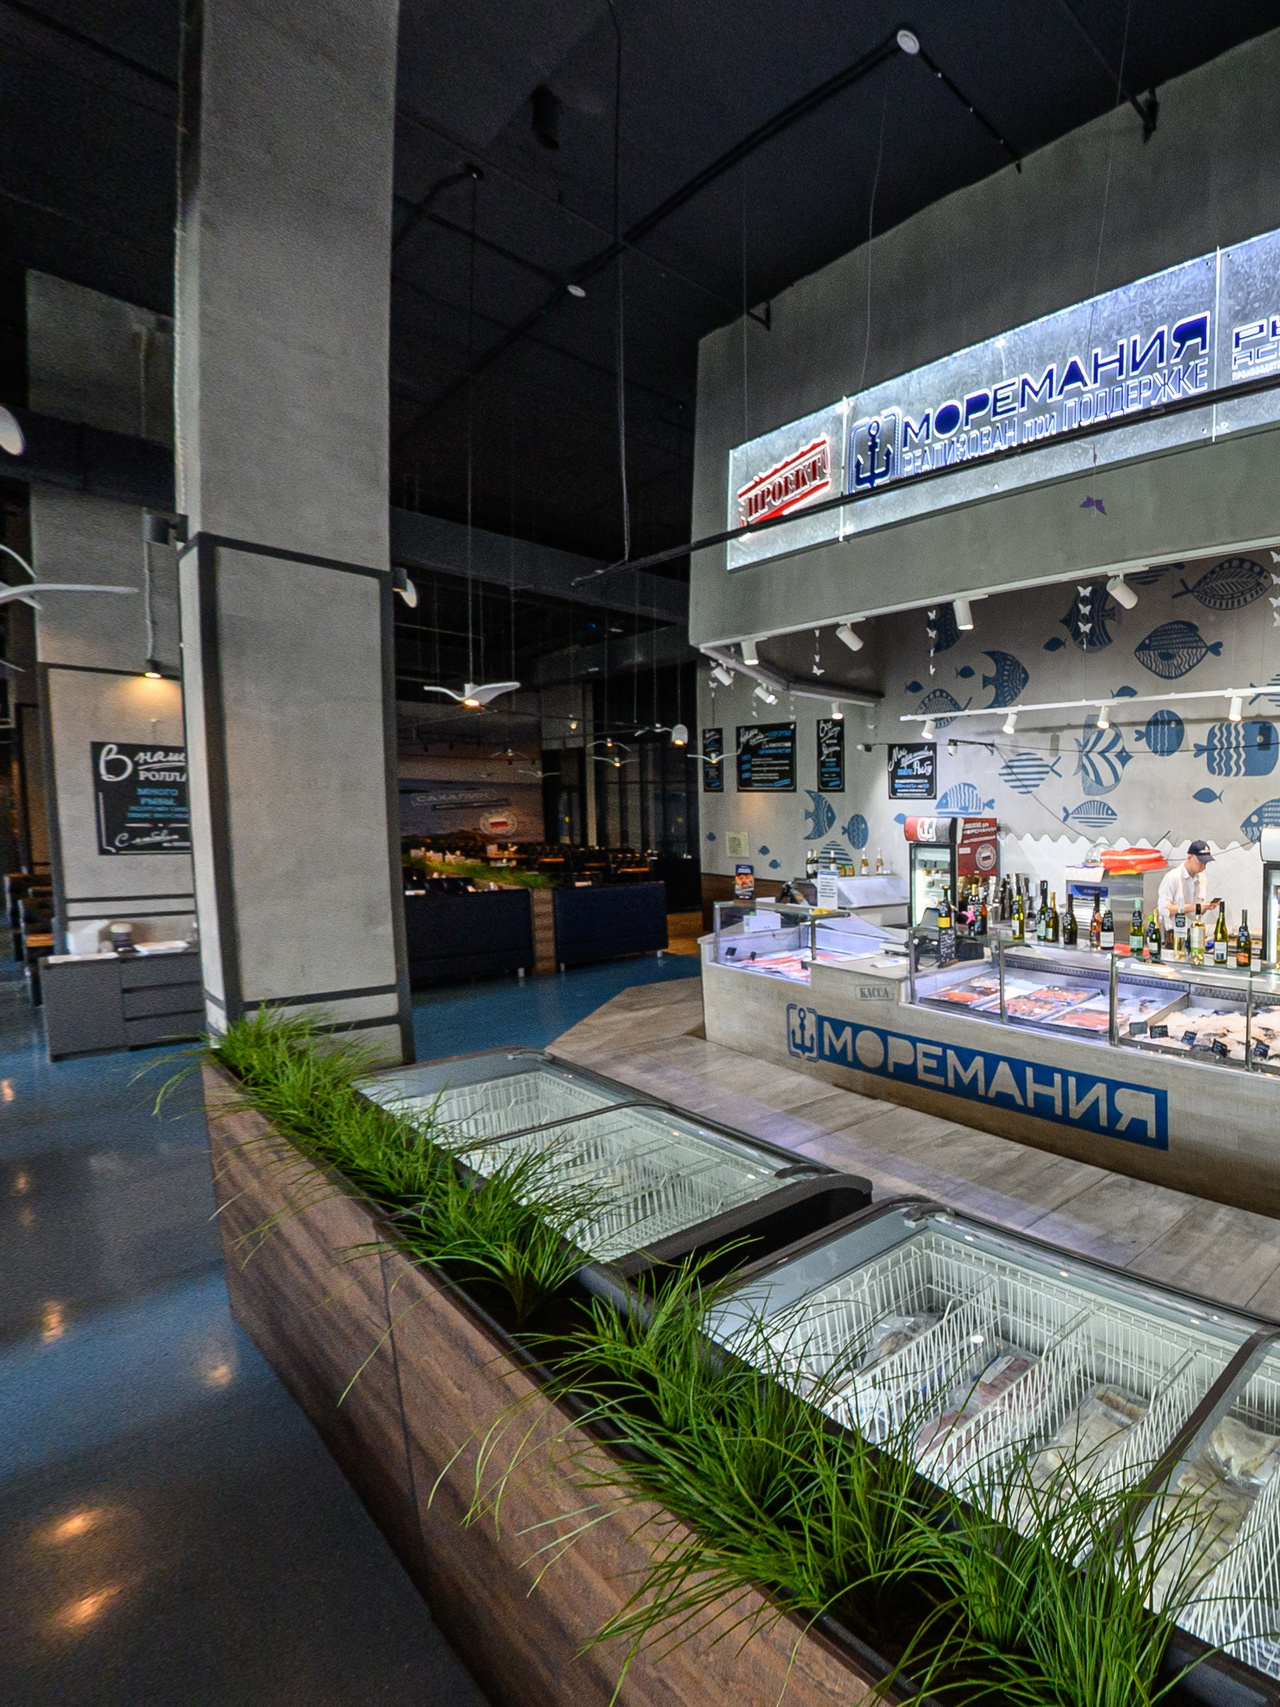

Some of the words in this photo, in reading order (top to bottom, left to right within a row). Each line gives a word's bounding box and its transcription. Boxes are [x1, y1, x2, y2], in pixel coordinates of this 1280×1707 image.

[902, 417, 1018, 476] РЕАЛИЗОВАН
[1062, 357, 1208, 430] ПОДДЕРЖКЕ
[903, 311, 1212, 451] МОРЕМАНИЯ
[747, 454, 821, 521] ПРОЕКТ
[99, 744, 133, 782] В
[134, 751, 187, 765] наш
[859, 986, 890, 999] КАССА
[823, 1021, 1156, 1139] МОРЕМАНИЯ
